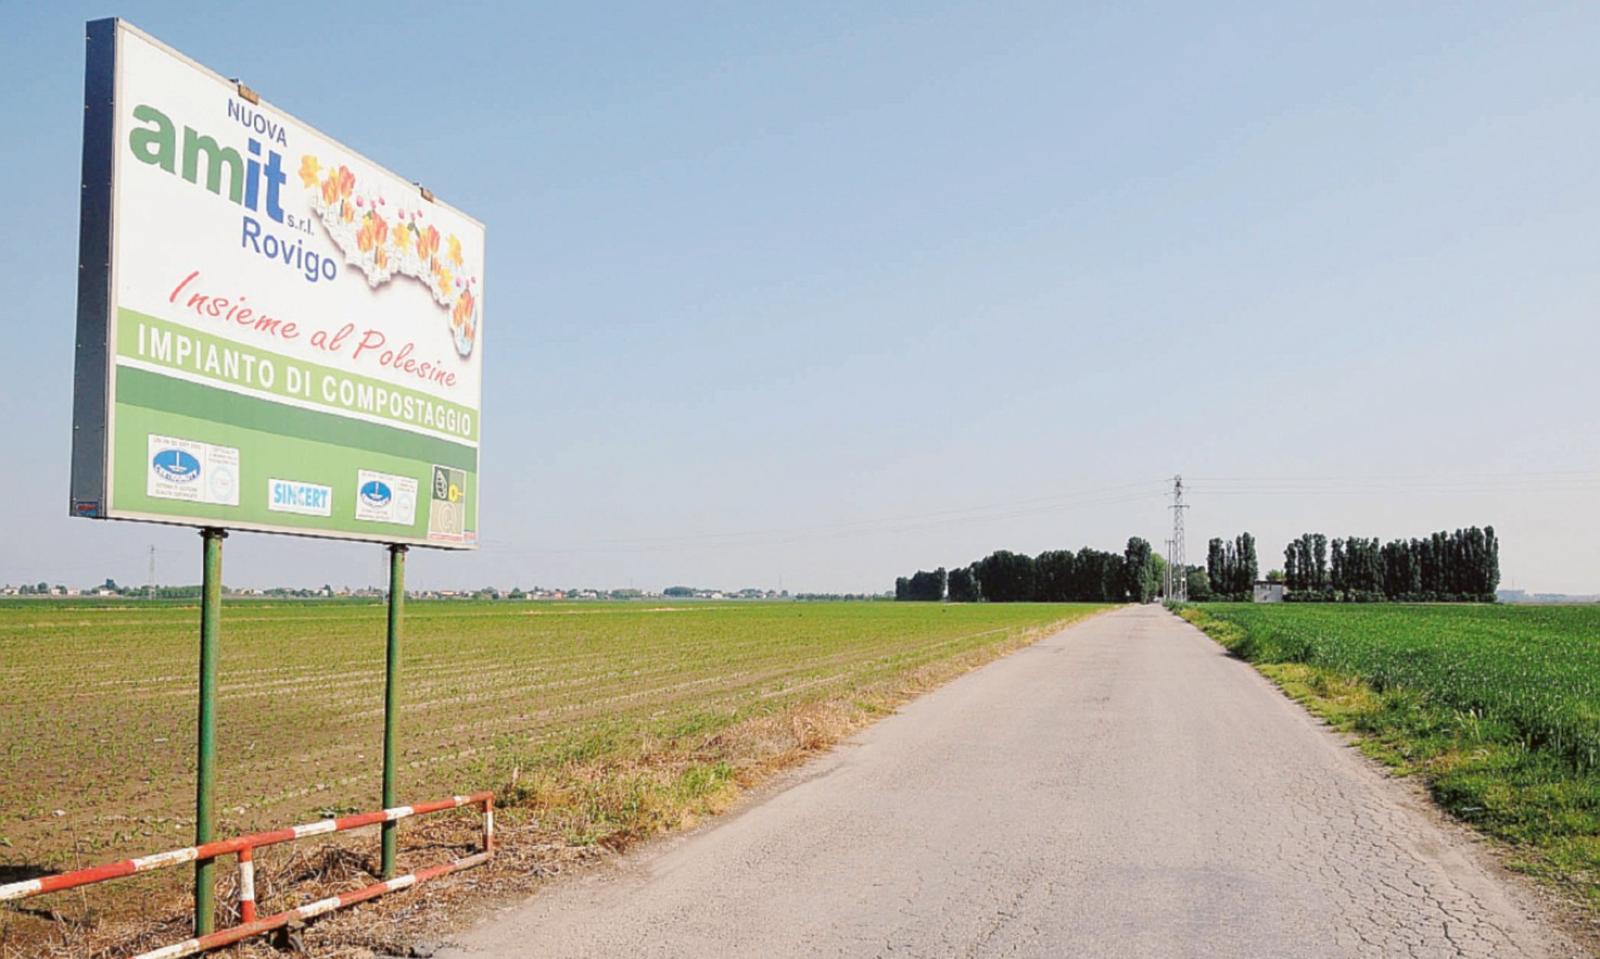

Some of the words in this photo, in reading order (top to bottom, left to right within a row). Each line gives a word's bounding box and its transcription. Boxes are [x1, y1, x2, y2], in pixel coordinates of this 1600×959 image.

[228, 98, 288, 147] NUOVA
[129, 104, 287, 223] amit
[287, 212, 315, 236] s.r.l.
[241, 216, 337, 282] Rovigo
[169, 270, 300, 340] Insieme
[310, 323, 355, 353] al
[352, 329, 458, 387] Polesine
[138, 322, 275, 387] IMPIANTO
[286, 371, 311, 398] DI
[321, 374, 472, 437] COMPOSTAGGIO
[273, 482, 328, 508] SINCERT
